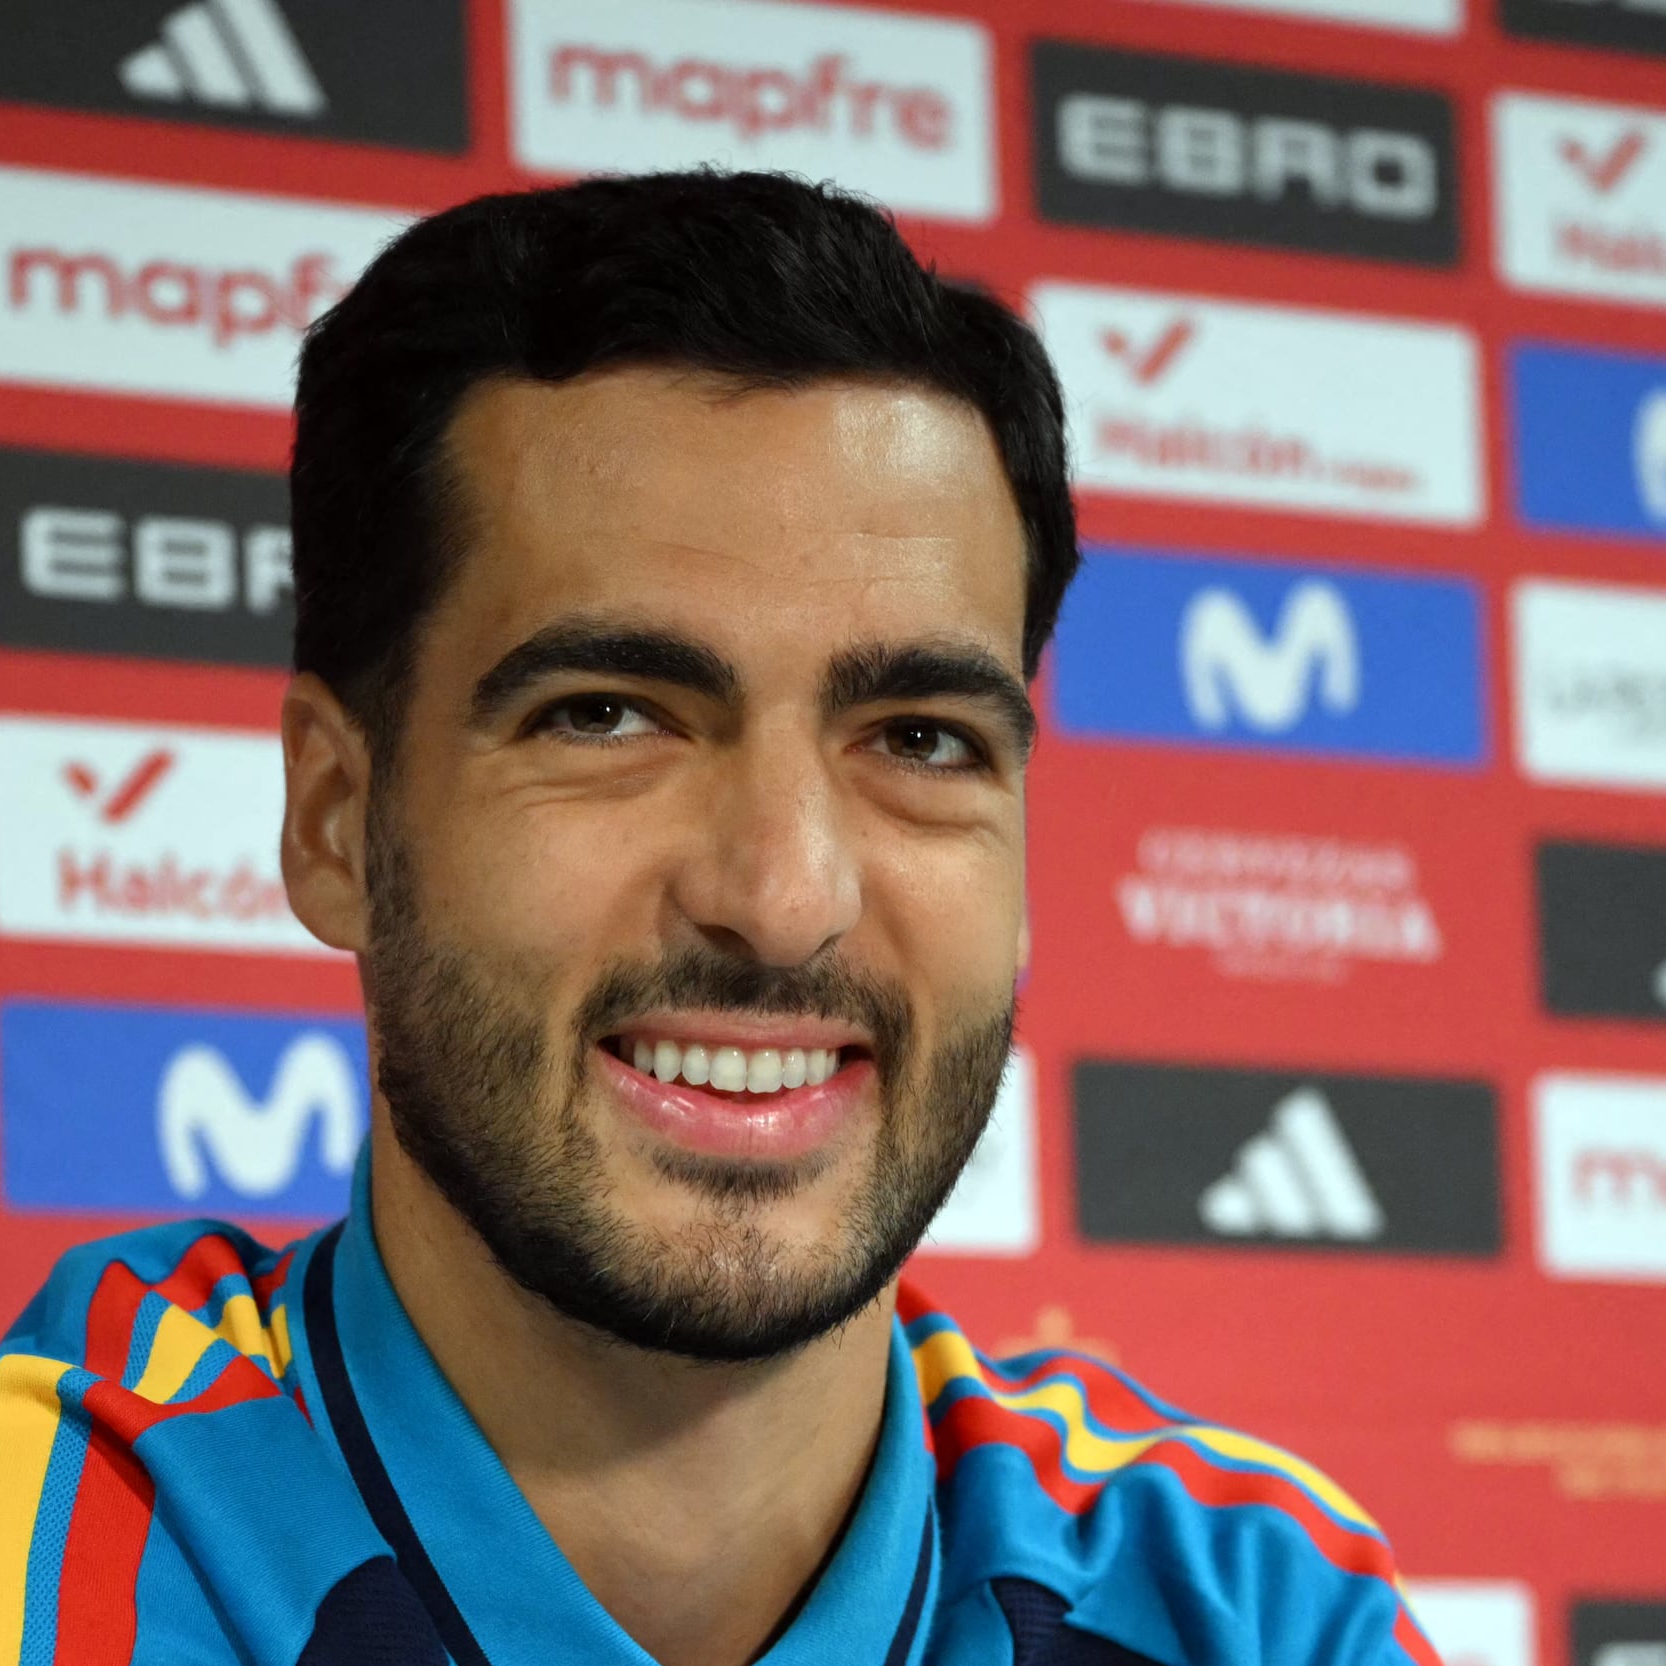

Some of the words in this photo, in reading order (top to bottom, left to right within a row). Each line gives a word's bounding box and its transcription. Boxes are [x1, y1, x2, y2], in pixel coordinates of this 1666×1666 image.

[548, 44, 951, 150] mapfre
[1057, 92, 1436, 216] EBRO
[9, 249, 336, 350] mapf
